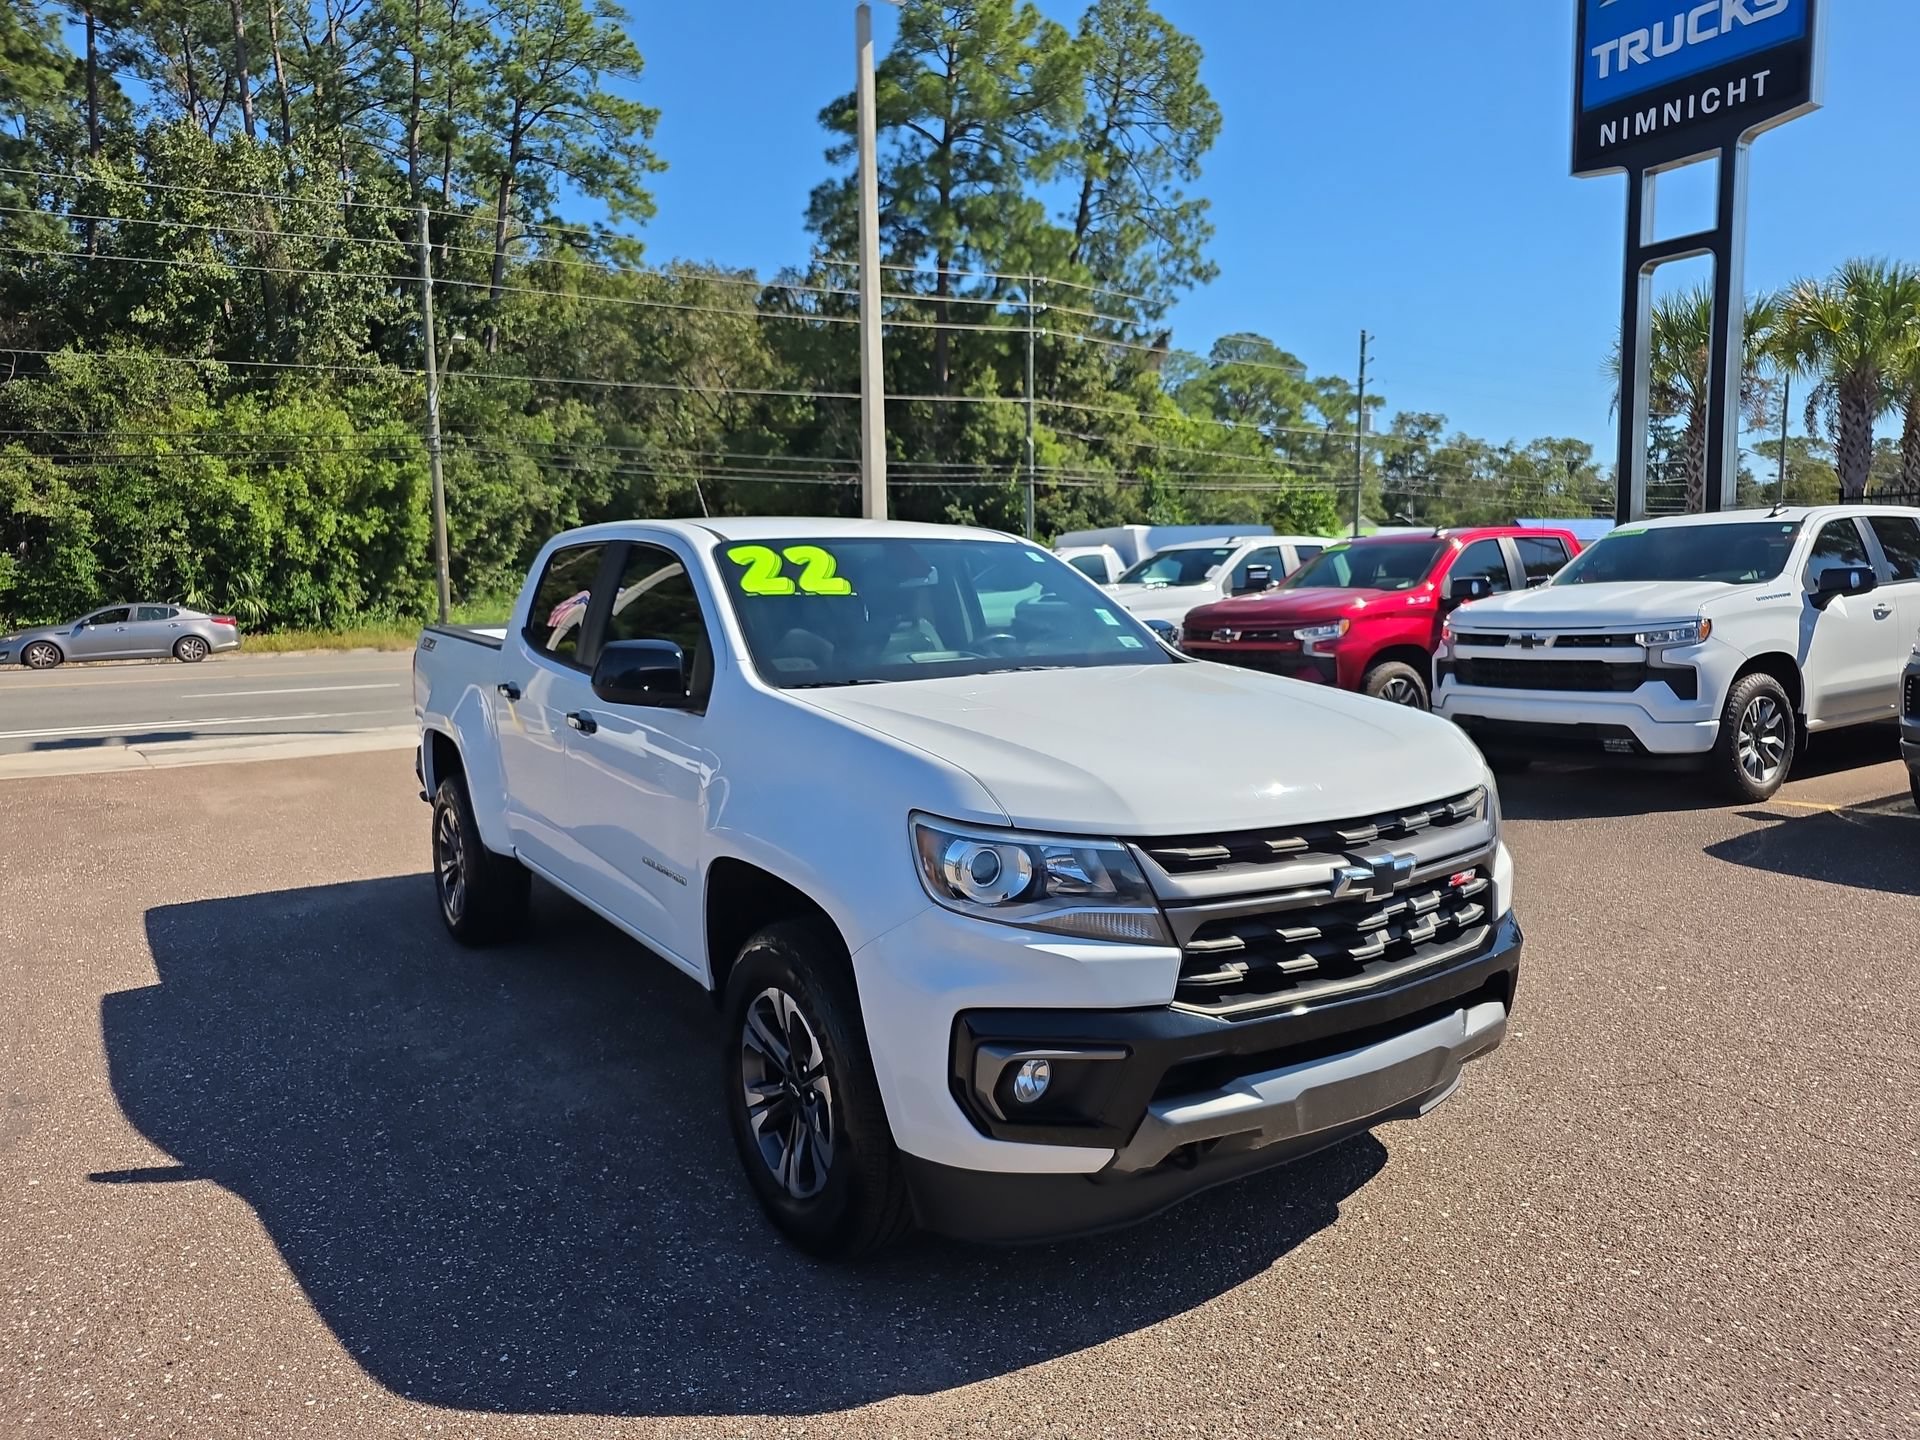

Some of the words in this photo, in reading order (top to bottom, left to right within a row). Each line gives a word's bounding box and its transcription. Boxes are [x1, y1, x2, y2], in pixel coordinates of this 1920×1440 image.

[1592, 0, 1788, 79] TRUCKS
[1600, 70, 1770, 147] NIMNICHT
[727, 545, 852, 595] 22
